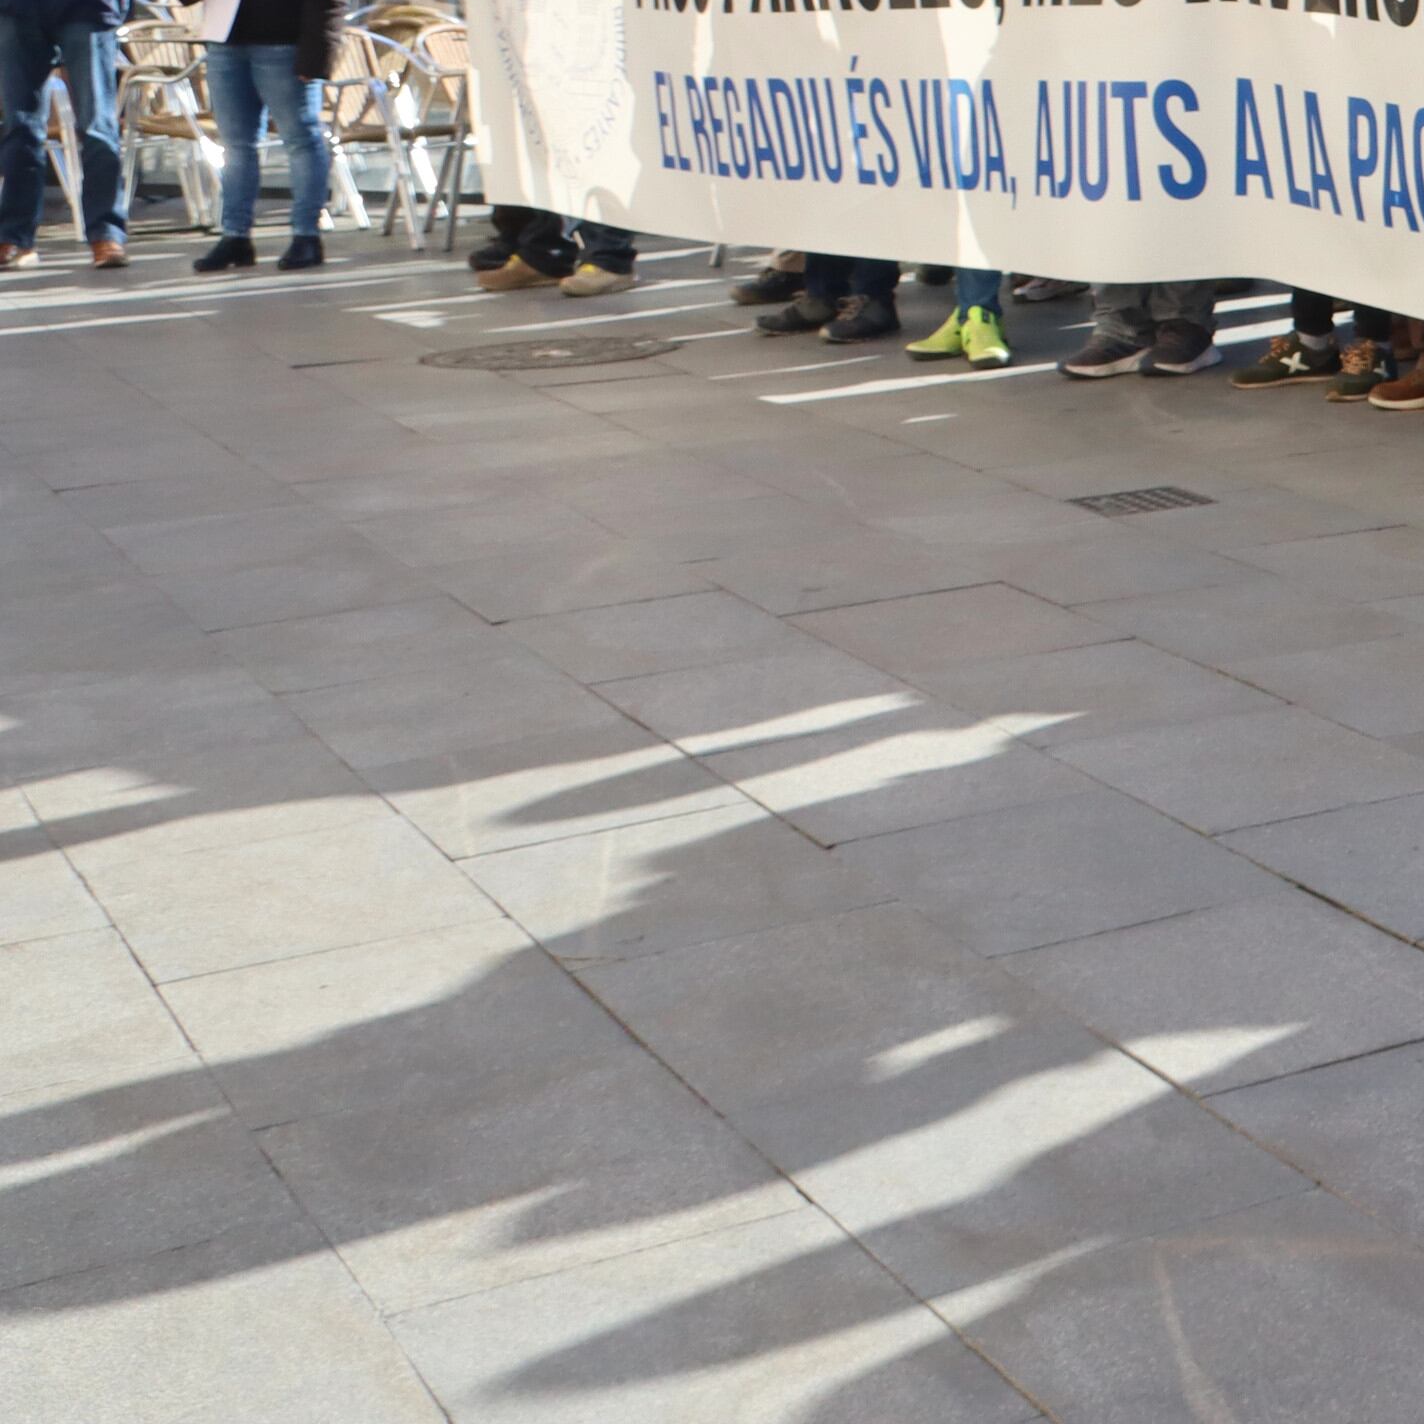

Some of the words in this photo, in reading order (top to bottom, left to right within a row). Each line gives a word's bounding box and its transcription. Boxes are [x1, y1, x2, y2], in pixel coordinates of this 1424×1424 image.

[653, 70, 692, 172] EL
[686, 72, 844, 185] REGADIU
[846, 55, 900, 188] ÉS
[899, 78, 1017, 210] VIDA,
[1035, 78, 1208, 203] AJUTS
[1235, 77, 1275, 202] A
[1274, 83, 1342, 217] LA
